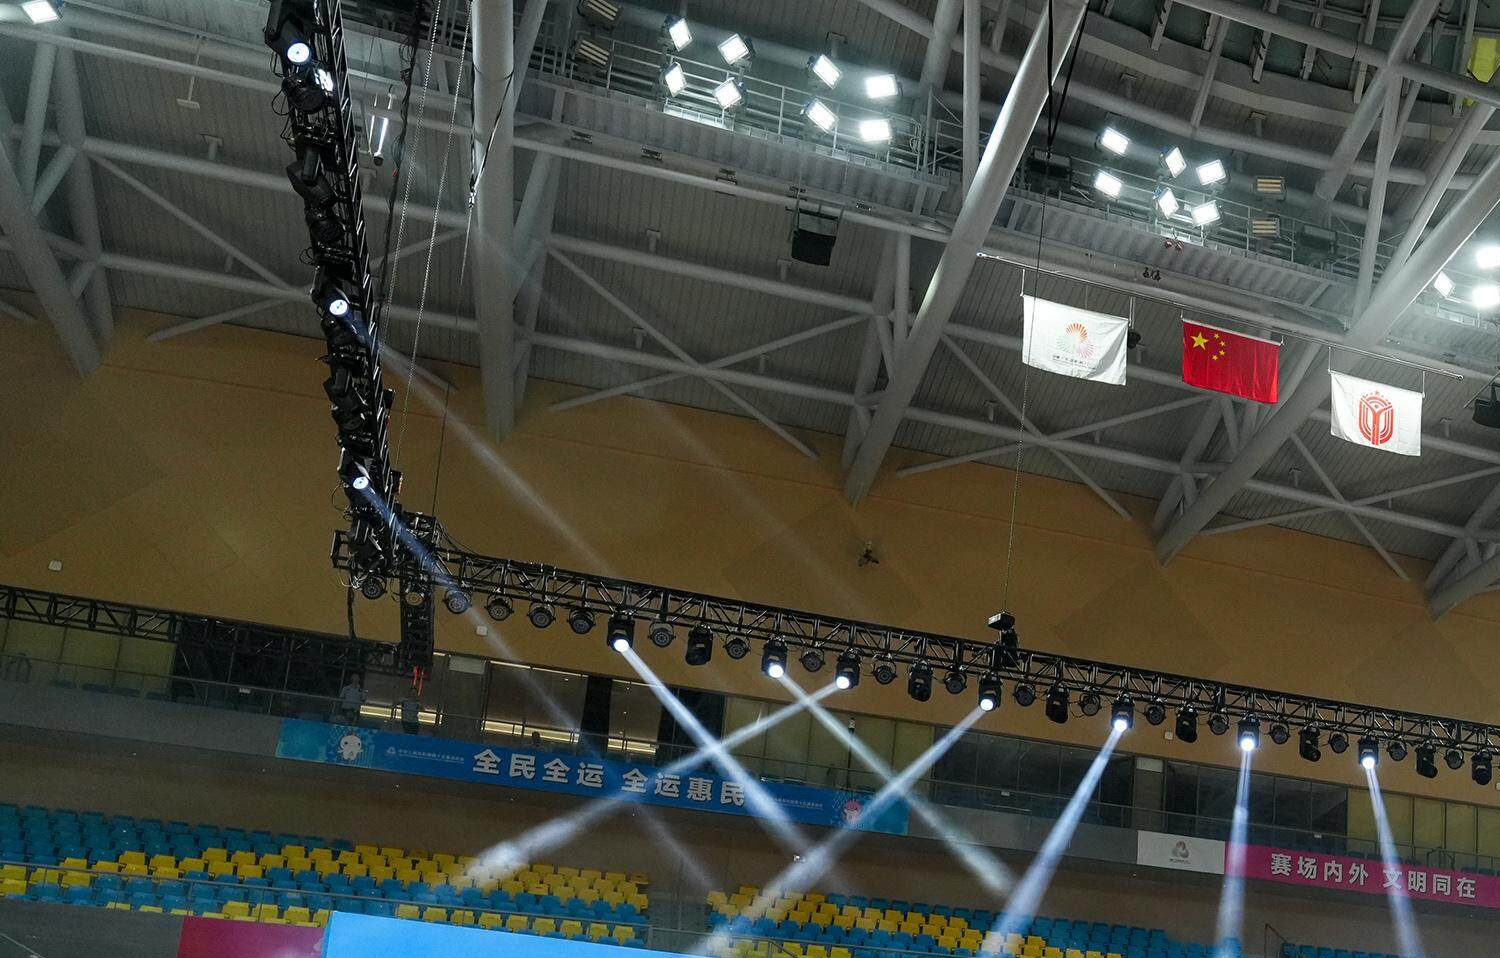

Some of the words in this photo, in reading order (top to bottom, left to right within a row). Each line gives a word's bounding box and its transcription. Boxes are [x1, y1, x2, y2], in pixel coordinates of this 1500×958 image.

[472, 748, 604, 787] 全民全运
[621, 768, 746, 806] 全运惠民
[1271, 853, 1369, 885] 赛场内外
[1383, 868, 1476, 898] 文明同在
